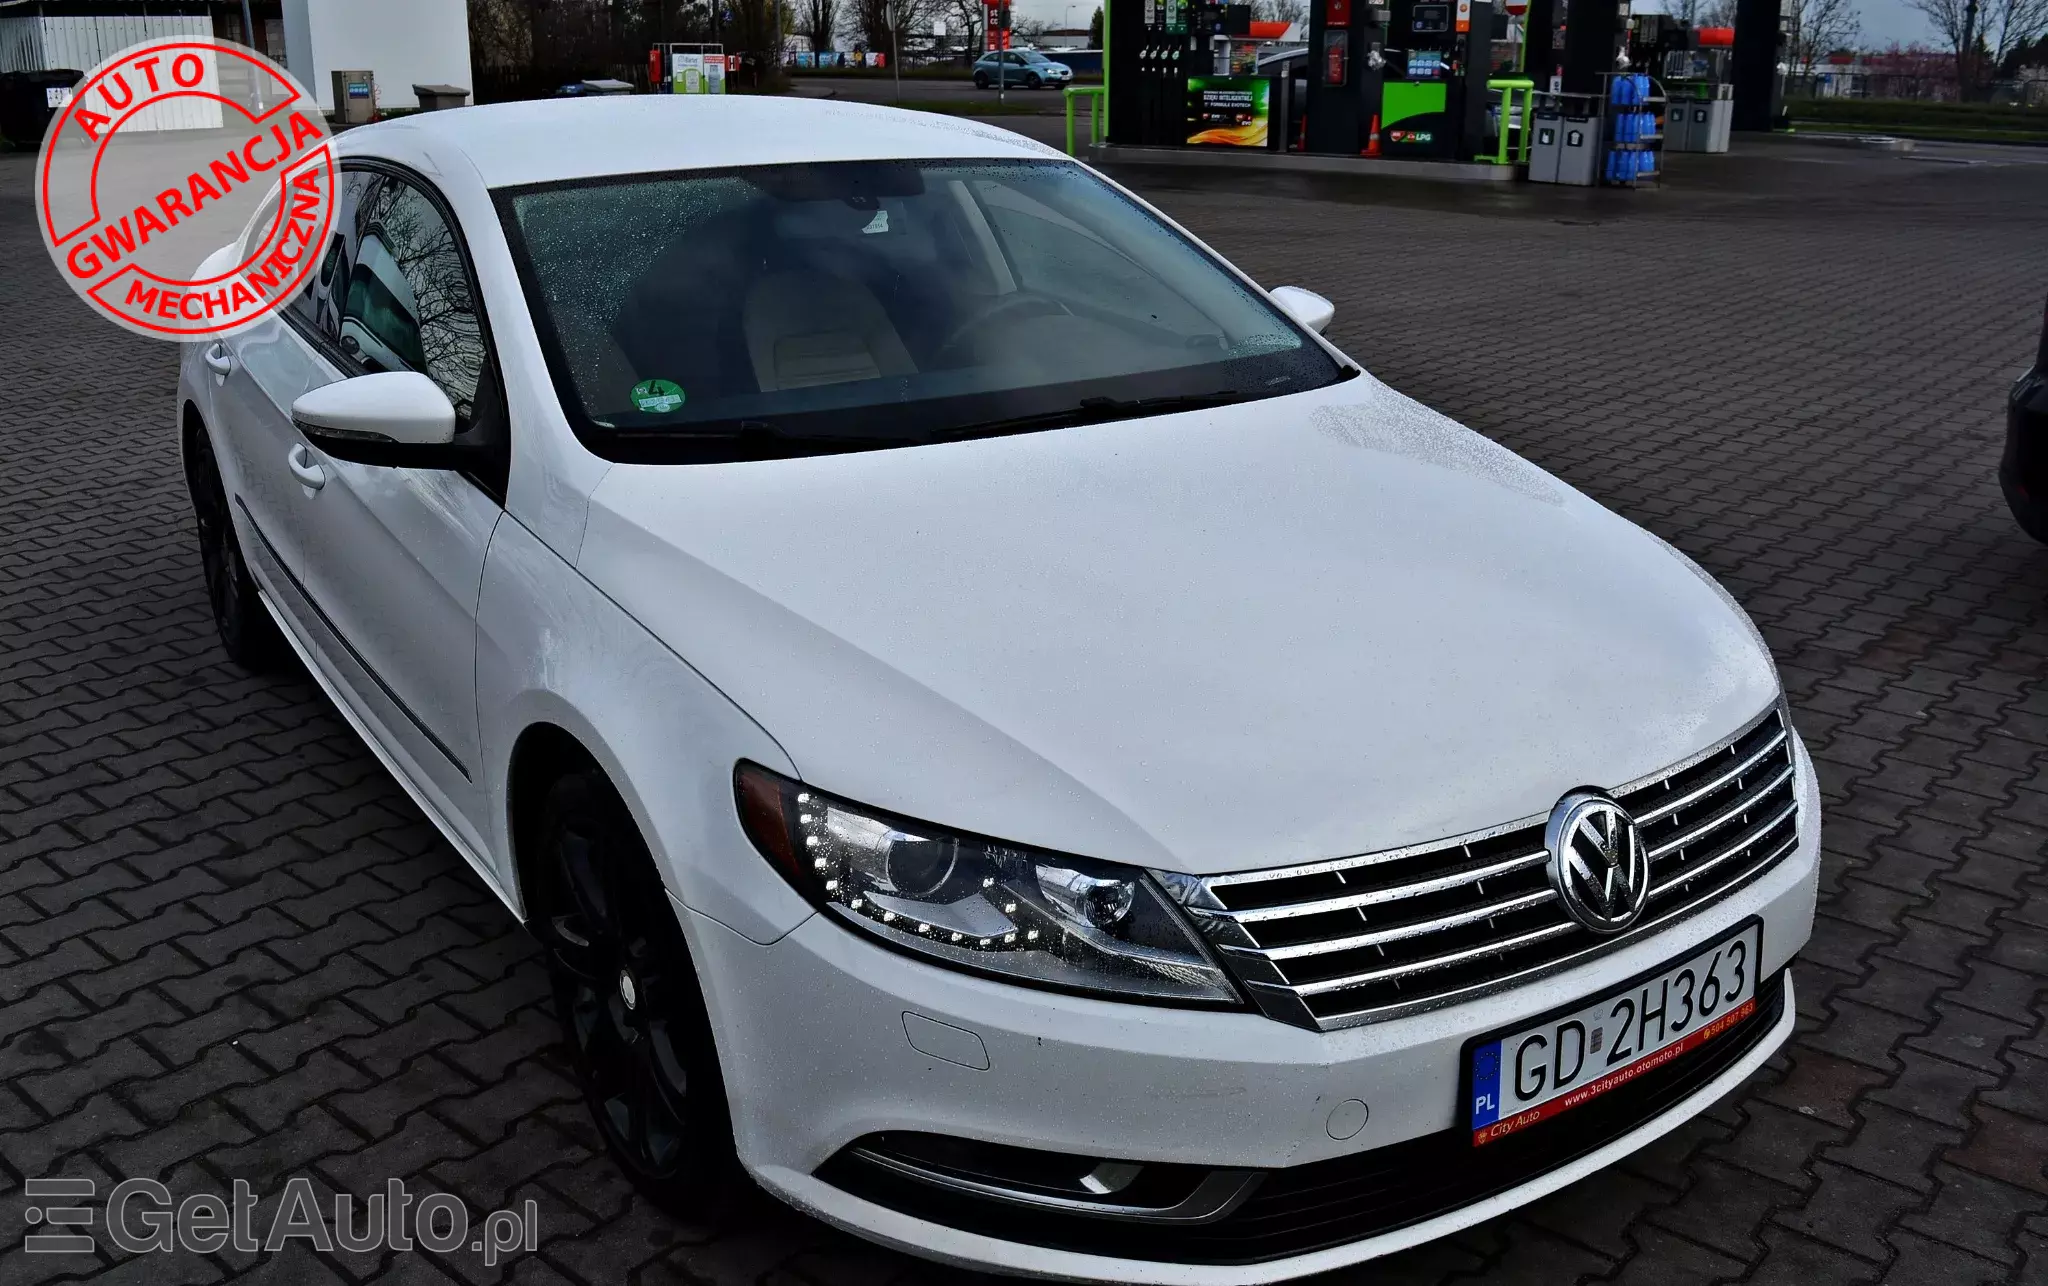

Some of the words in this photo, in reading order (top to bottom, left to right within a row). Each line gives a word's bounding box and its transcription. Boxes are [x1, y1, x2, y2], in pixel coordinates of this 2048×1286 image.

[1415, 133, 1431, 141] LPG
[648, 380, 664, 395] 4
[1514, 1019, 1586, 1101] GD
[1606, 939, 1747, 1067] 2H363
[1490, 1121, 1515, 1137] City
[1515, 1110, 1540, 1127] Auto
[1564, 1042, 1684, 1107] www.3cityauto.otomoto.pl
[1711, 1020, 1725, 1035] 504
[1475, 1093, 1495, 1115] PL
